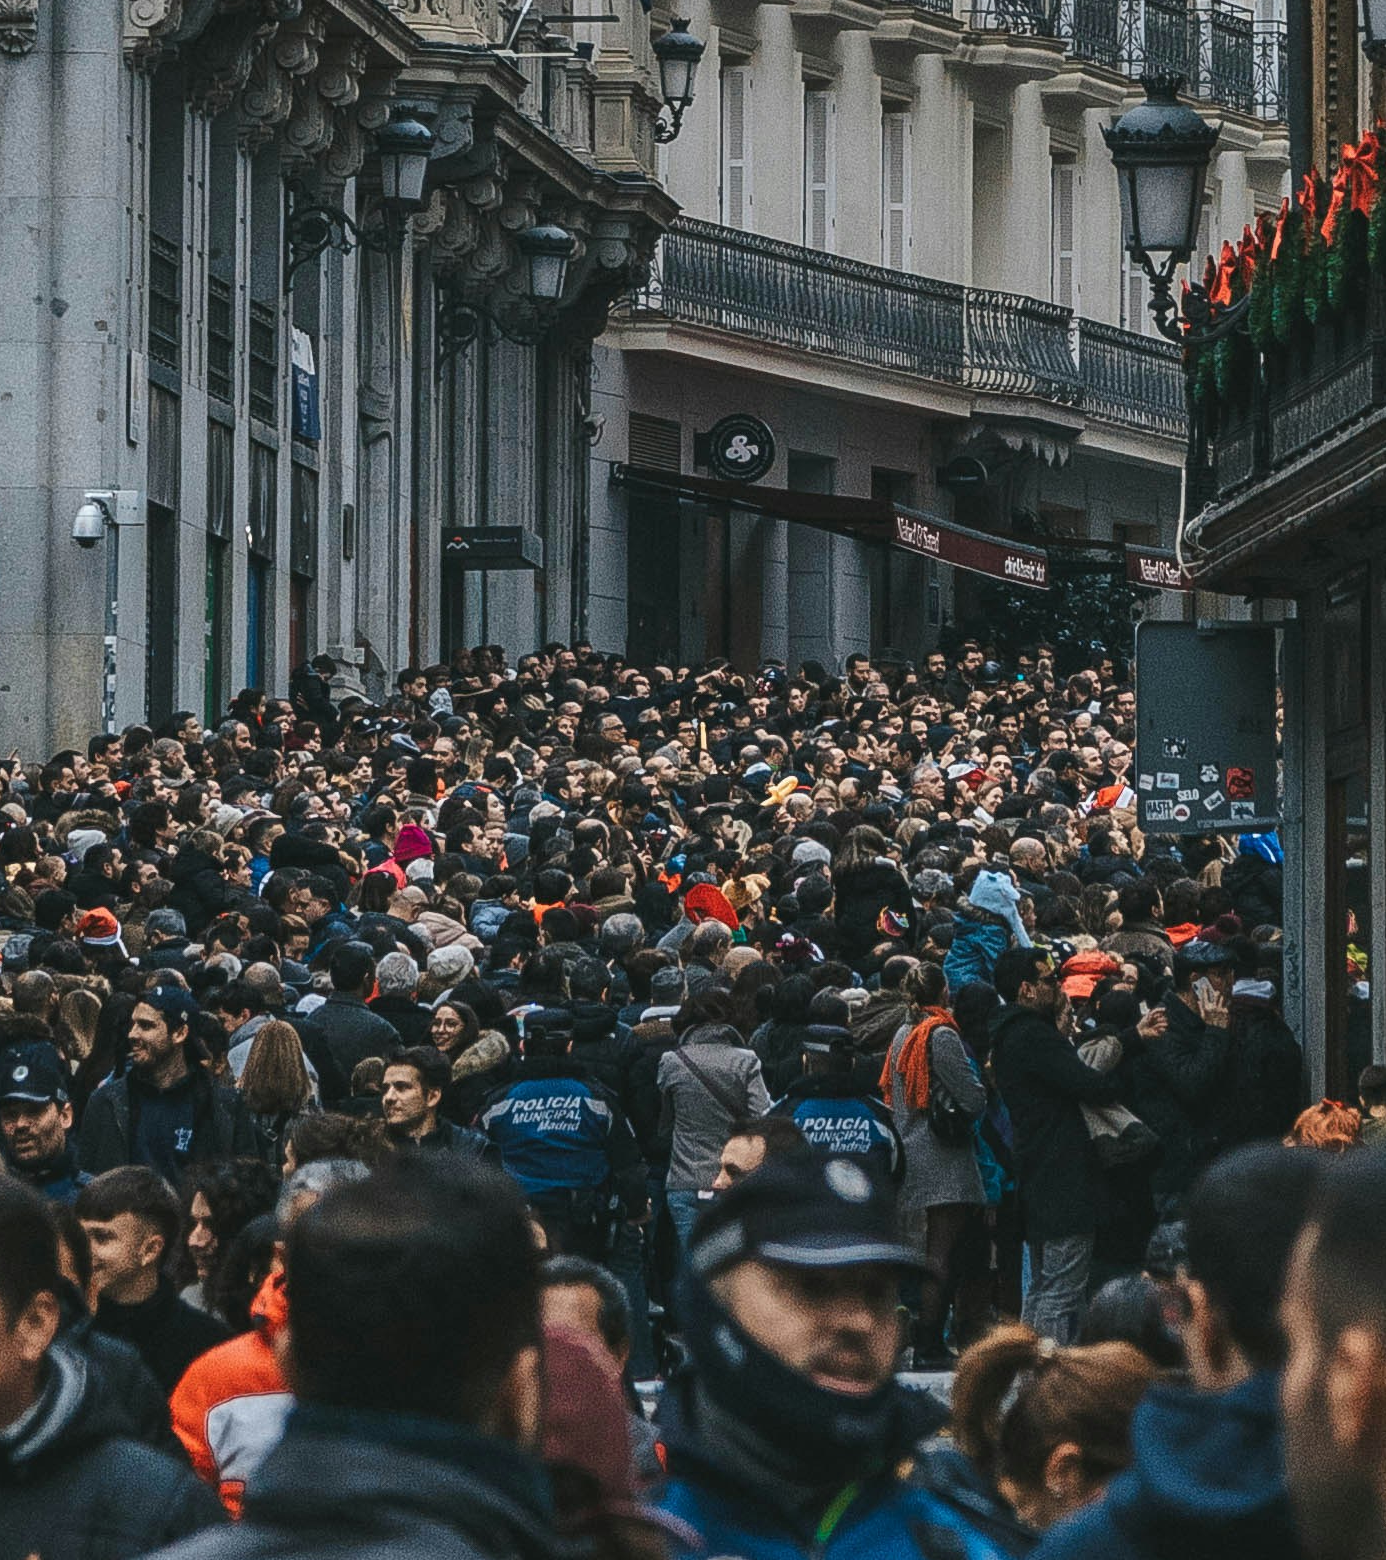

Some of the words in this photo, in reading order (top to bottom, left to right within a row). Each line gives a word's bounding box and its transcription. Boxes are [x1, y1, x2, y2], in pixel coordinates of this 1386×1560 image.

[512, 1094, 581, 1113] POLICÍA
[512, 1109, 582, 1124] MUNICIPAL
[802, 1116, 870, 1131] POLICÍA
[537, 1120, 581, 1133] Madrid
